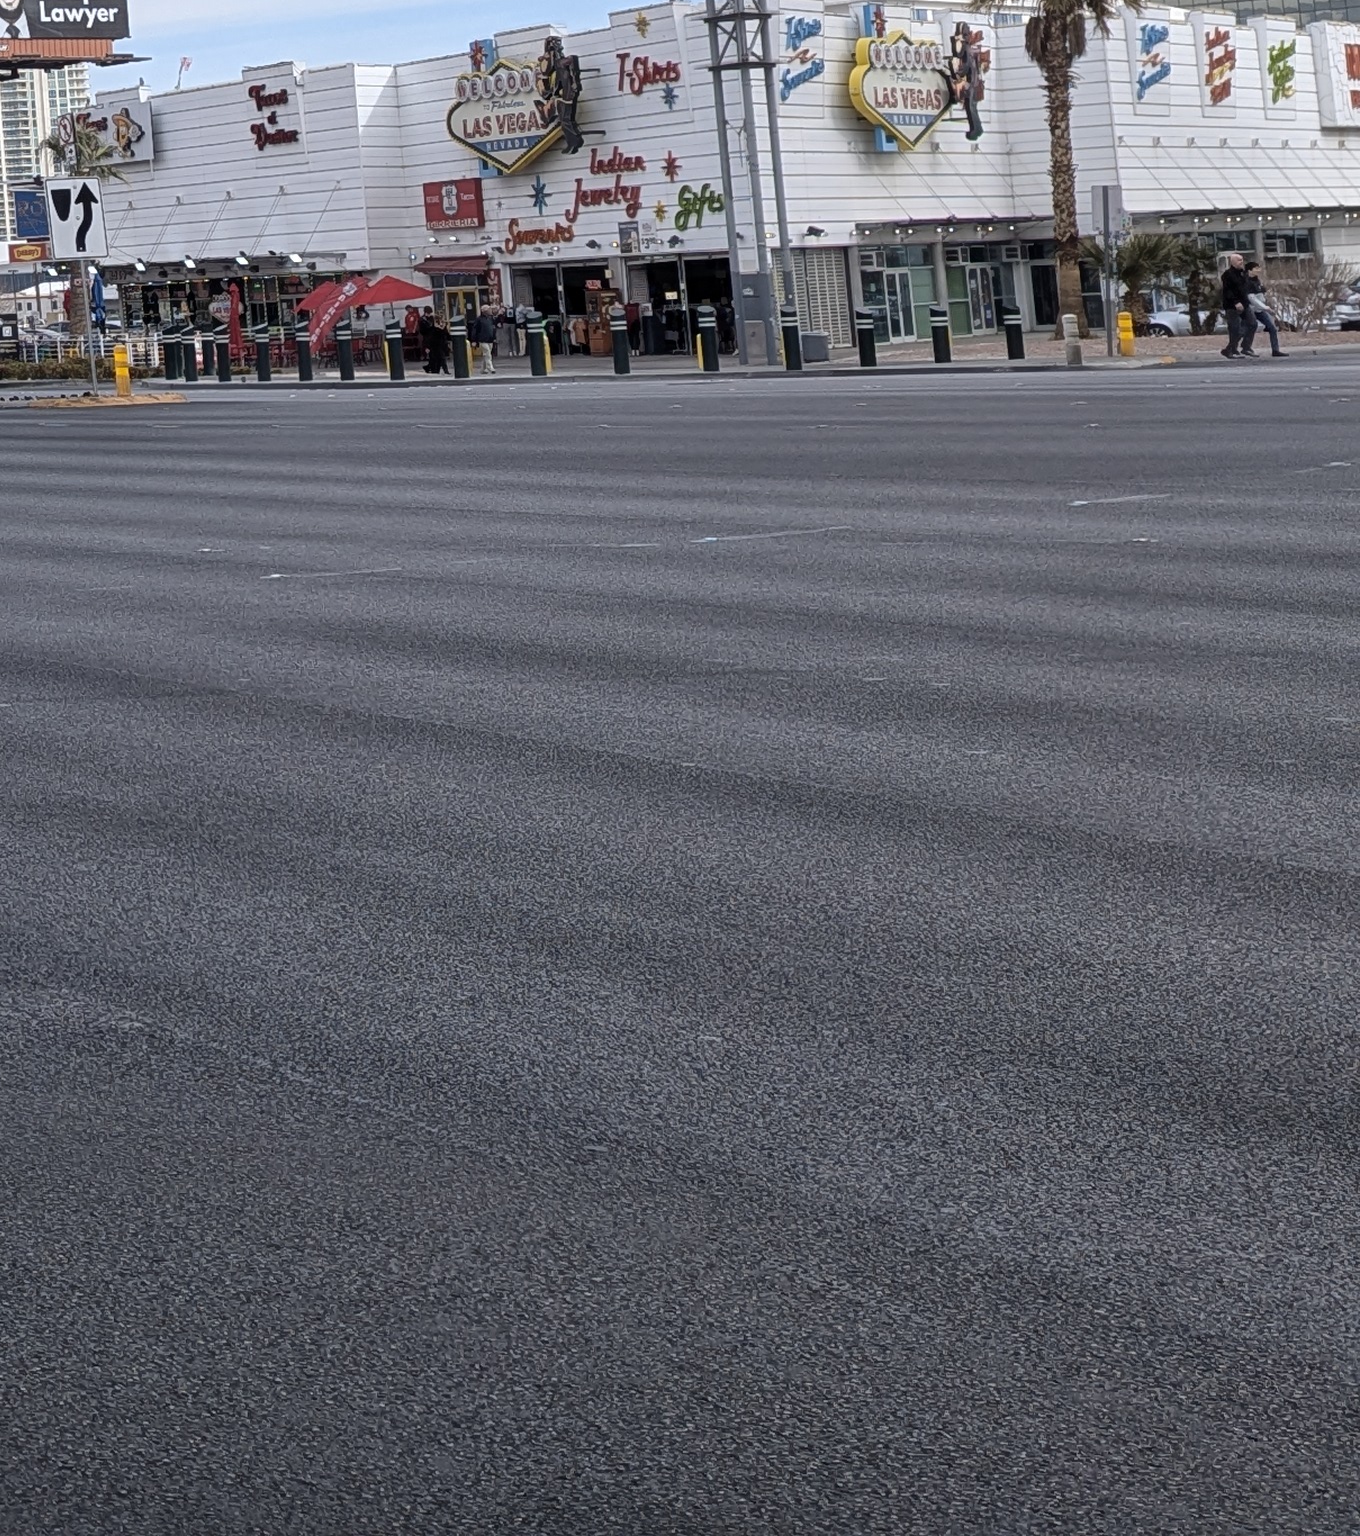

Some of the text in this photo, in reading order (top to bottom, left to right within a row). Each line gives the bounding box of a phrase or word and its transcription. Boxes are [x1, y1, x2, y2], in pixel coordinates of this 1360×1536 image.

[38, 0, 119, 28] Lawyer
[870, 44, 944, 69] WELCOME
[616, 52, 682, 96] T-Shirts
[873, 86, 944, 111] LAS VEGAS
[462, 114, 493, 139] LAS
[892, 115, 928, 126] NEVADA
[485, 139, 530, 153] NEVADA
[564, 173, 643, 224] Jewelry
[674, 182, 726, 232] Gifts
[15, 247, 41, 258] Denny's
